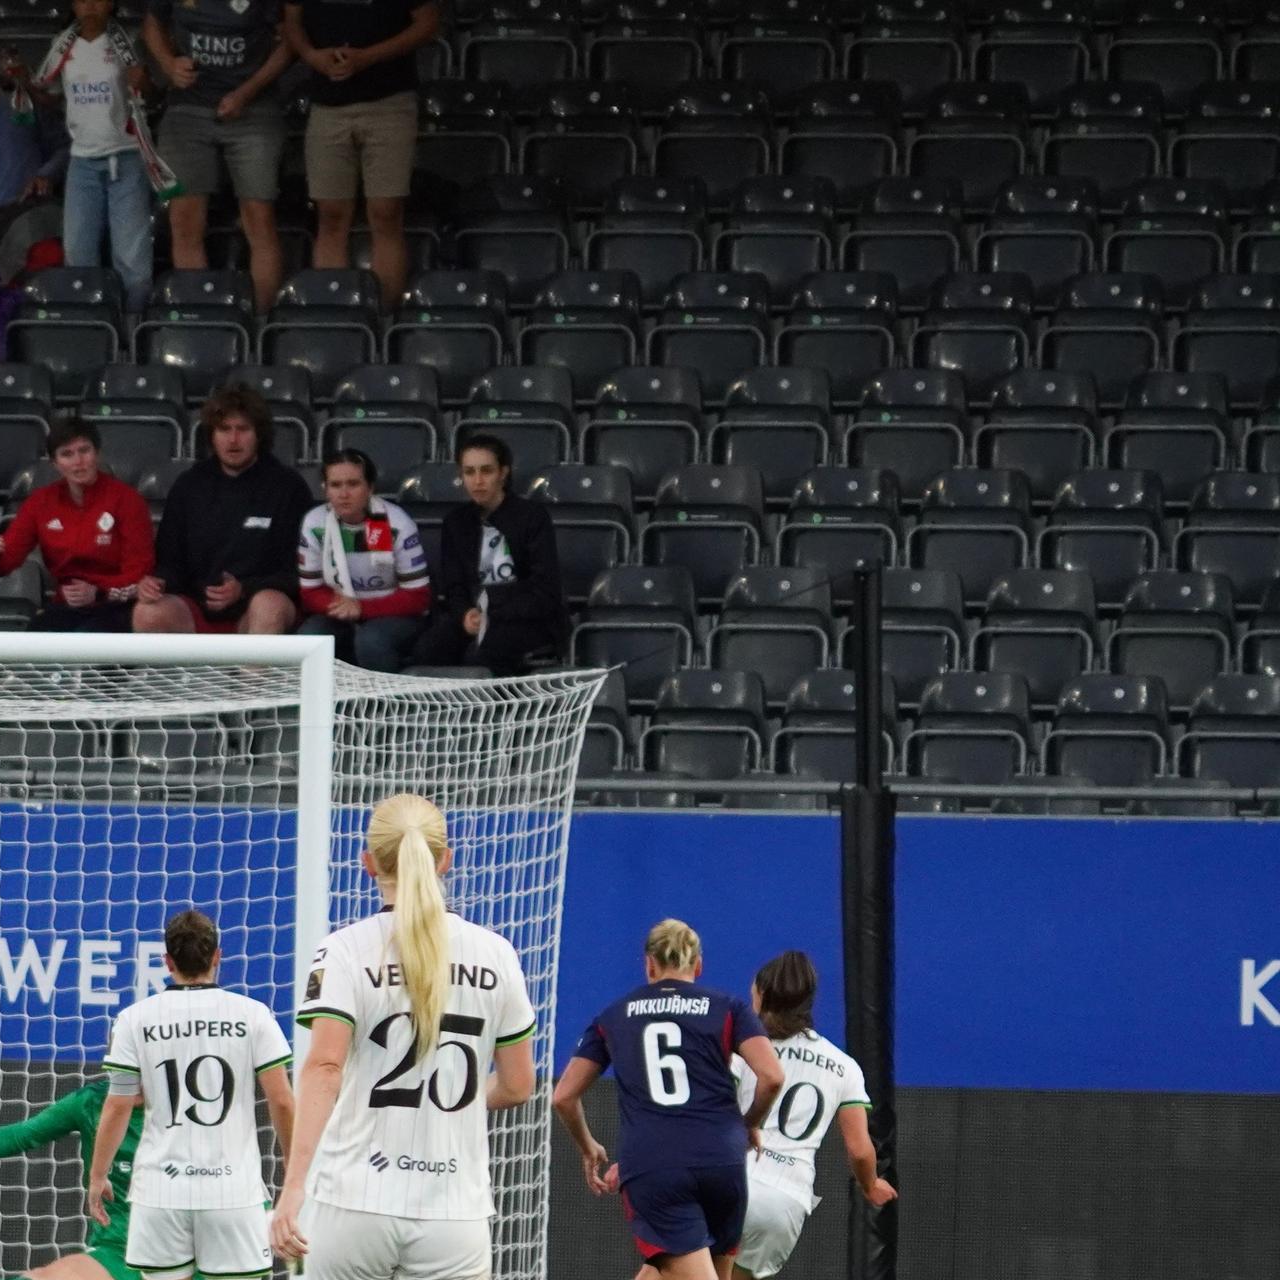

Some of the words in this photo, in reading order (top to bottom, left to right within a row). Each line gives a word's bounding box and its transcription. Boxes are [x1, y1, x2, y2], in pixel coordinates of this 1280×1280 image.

[190, 33, 246, 53] KING
[192, 51, 245, 66] POWER
[71, 81, 111, 95] KING
[74, 94, 111, 105] POWER
[365, 962, 499, 991] VEIND
[626, 994, 710, 1018] PIKKUJÄMSÄ
[143, 1020, 248, 1043] KUIJPERS
[368, 1011, 486, 1112] 25
[643, 1021, 691, 1107] 6
[773, 1045, 846, 1079] YNDERS
[155, 1054, 236, 1129] 19
[772, 1081, 826, 1142] 0
[397, 1155, 445, 1173] Group
[448, 1158, 458, 1173] S
[762, 1147, 787, 1164] roup
[185, 1166, 223, 1178] Group
[225, 1166, 233, 1176] S
